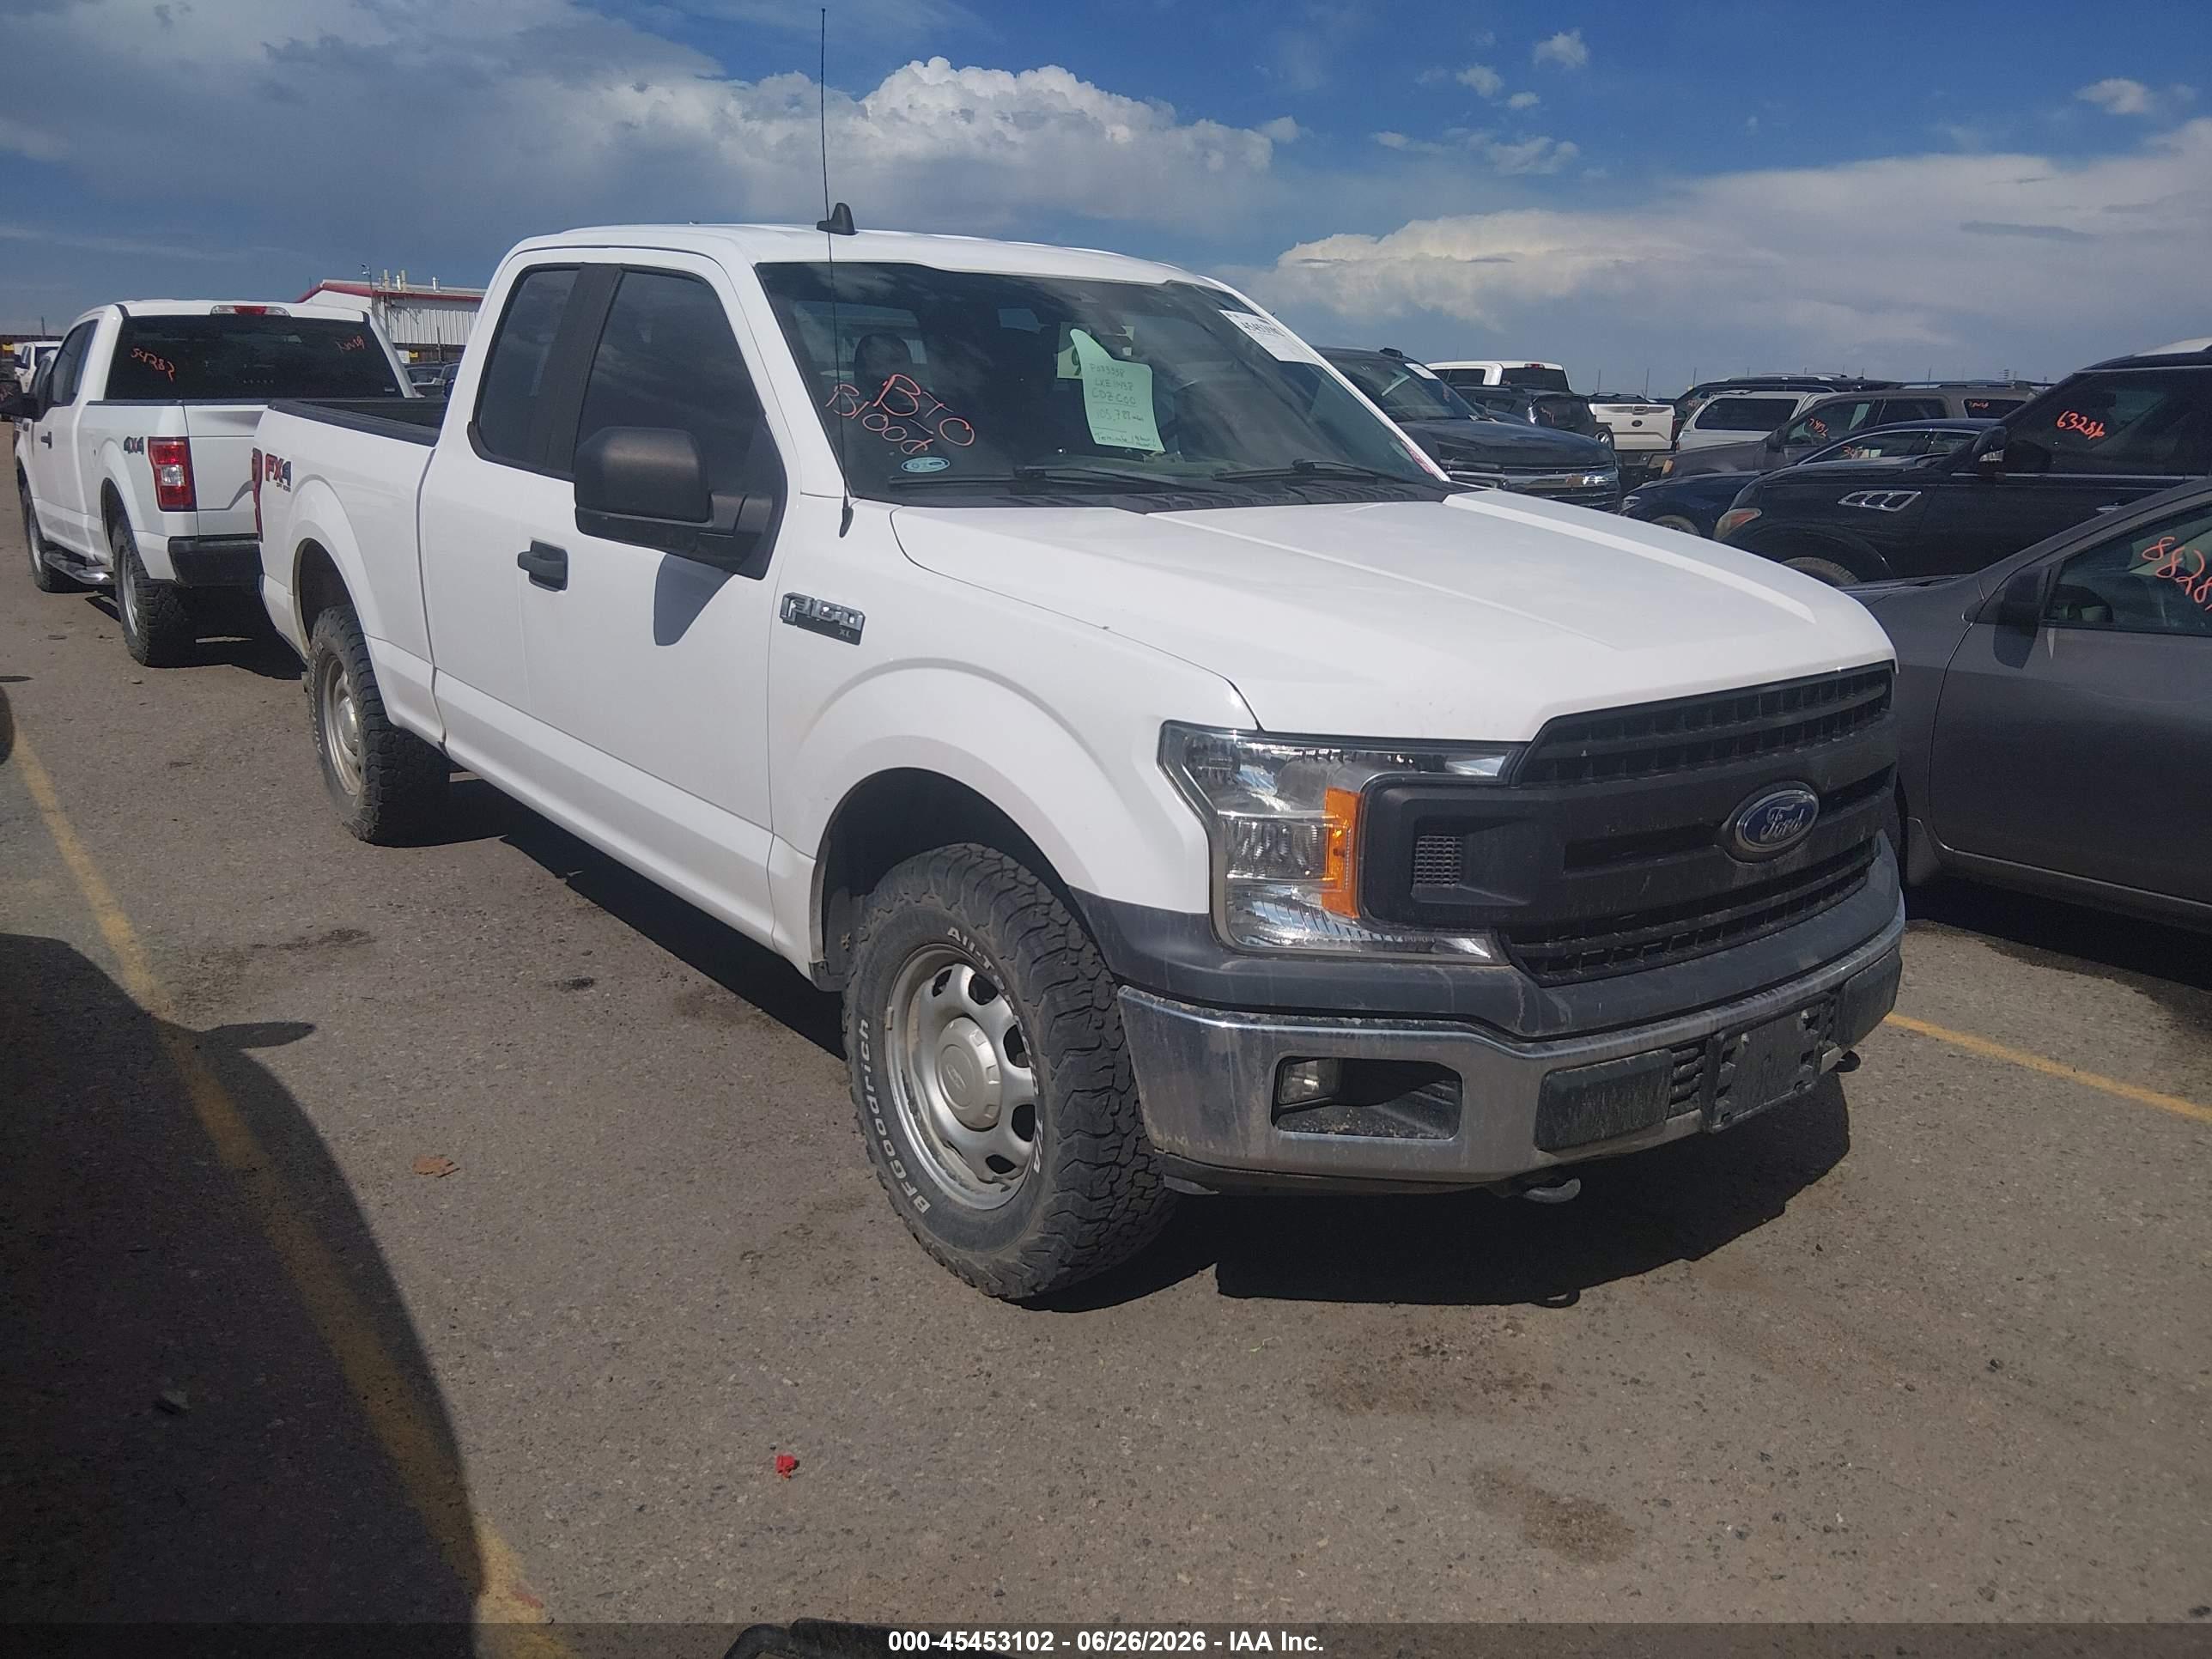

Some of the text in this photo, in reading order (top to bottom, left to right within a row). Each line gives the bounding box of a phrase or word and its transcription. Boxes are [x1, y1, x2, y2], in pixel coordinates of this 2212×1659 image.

[825, 384, 934, 455] Blood
[265, 453, 292, 487] FX4
[1759, 803, 1805, 842] Ford
[859, 1018, 931, 1213] BFGoodrich
